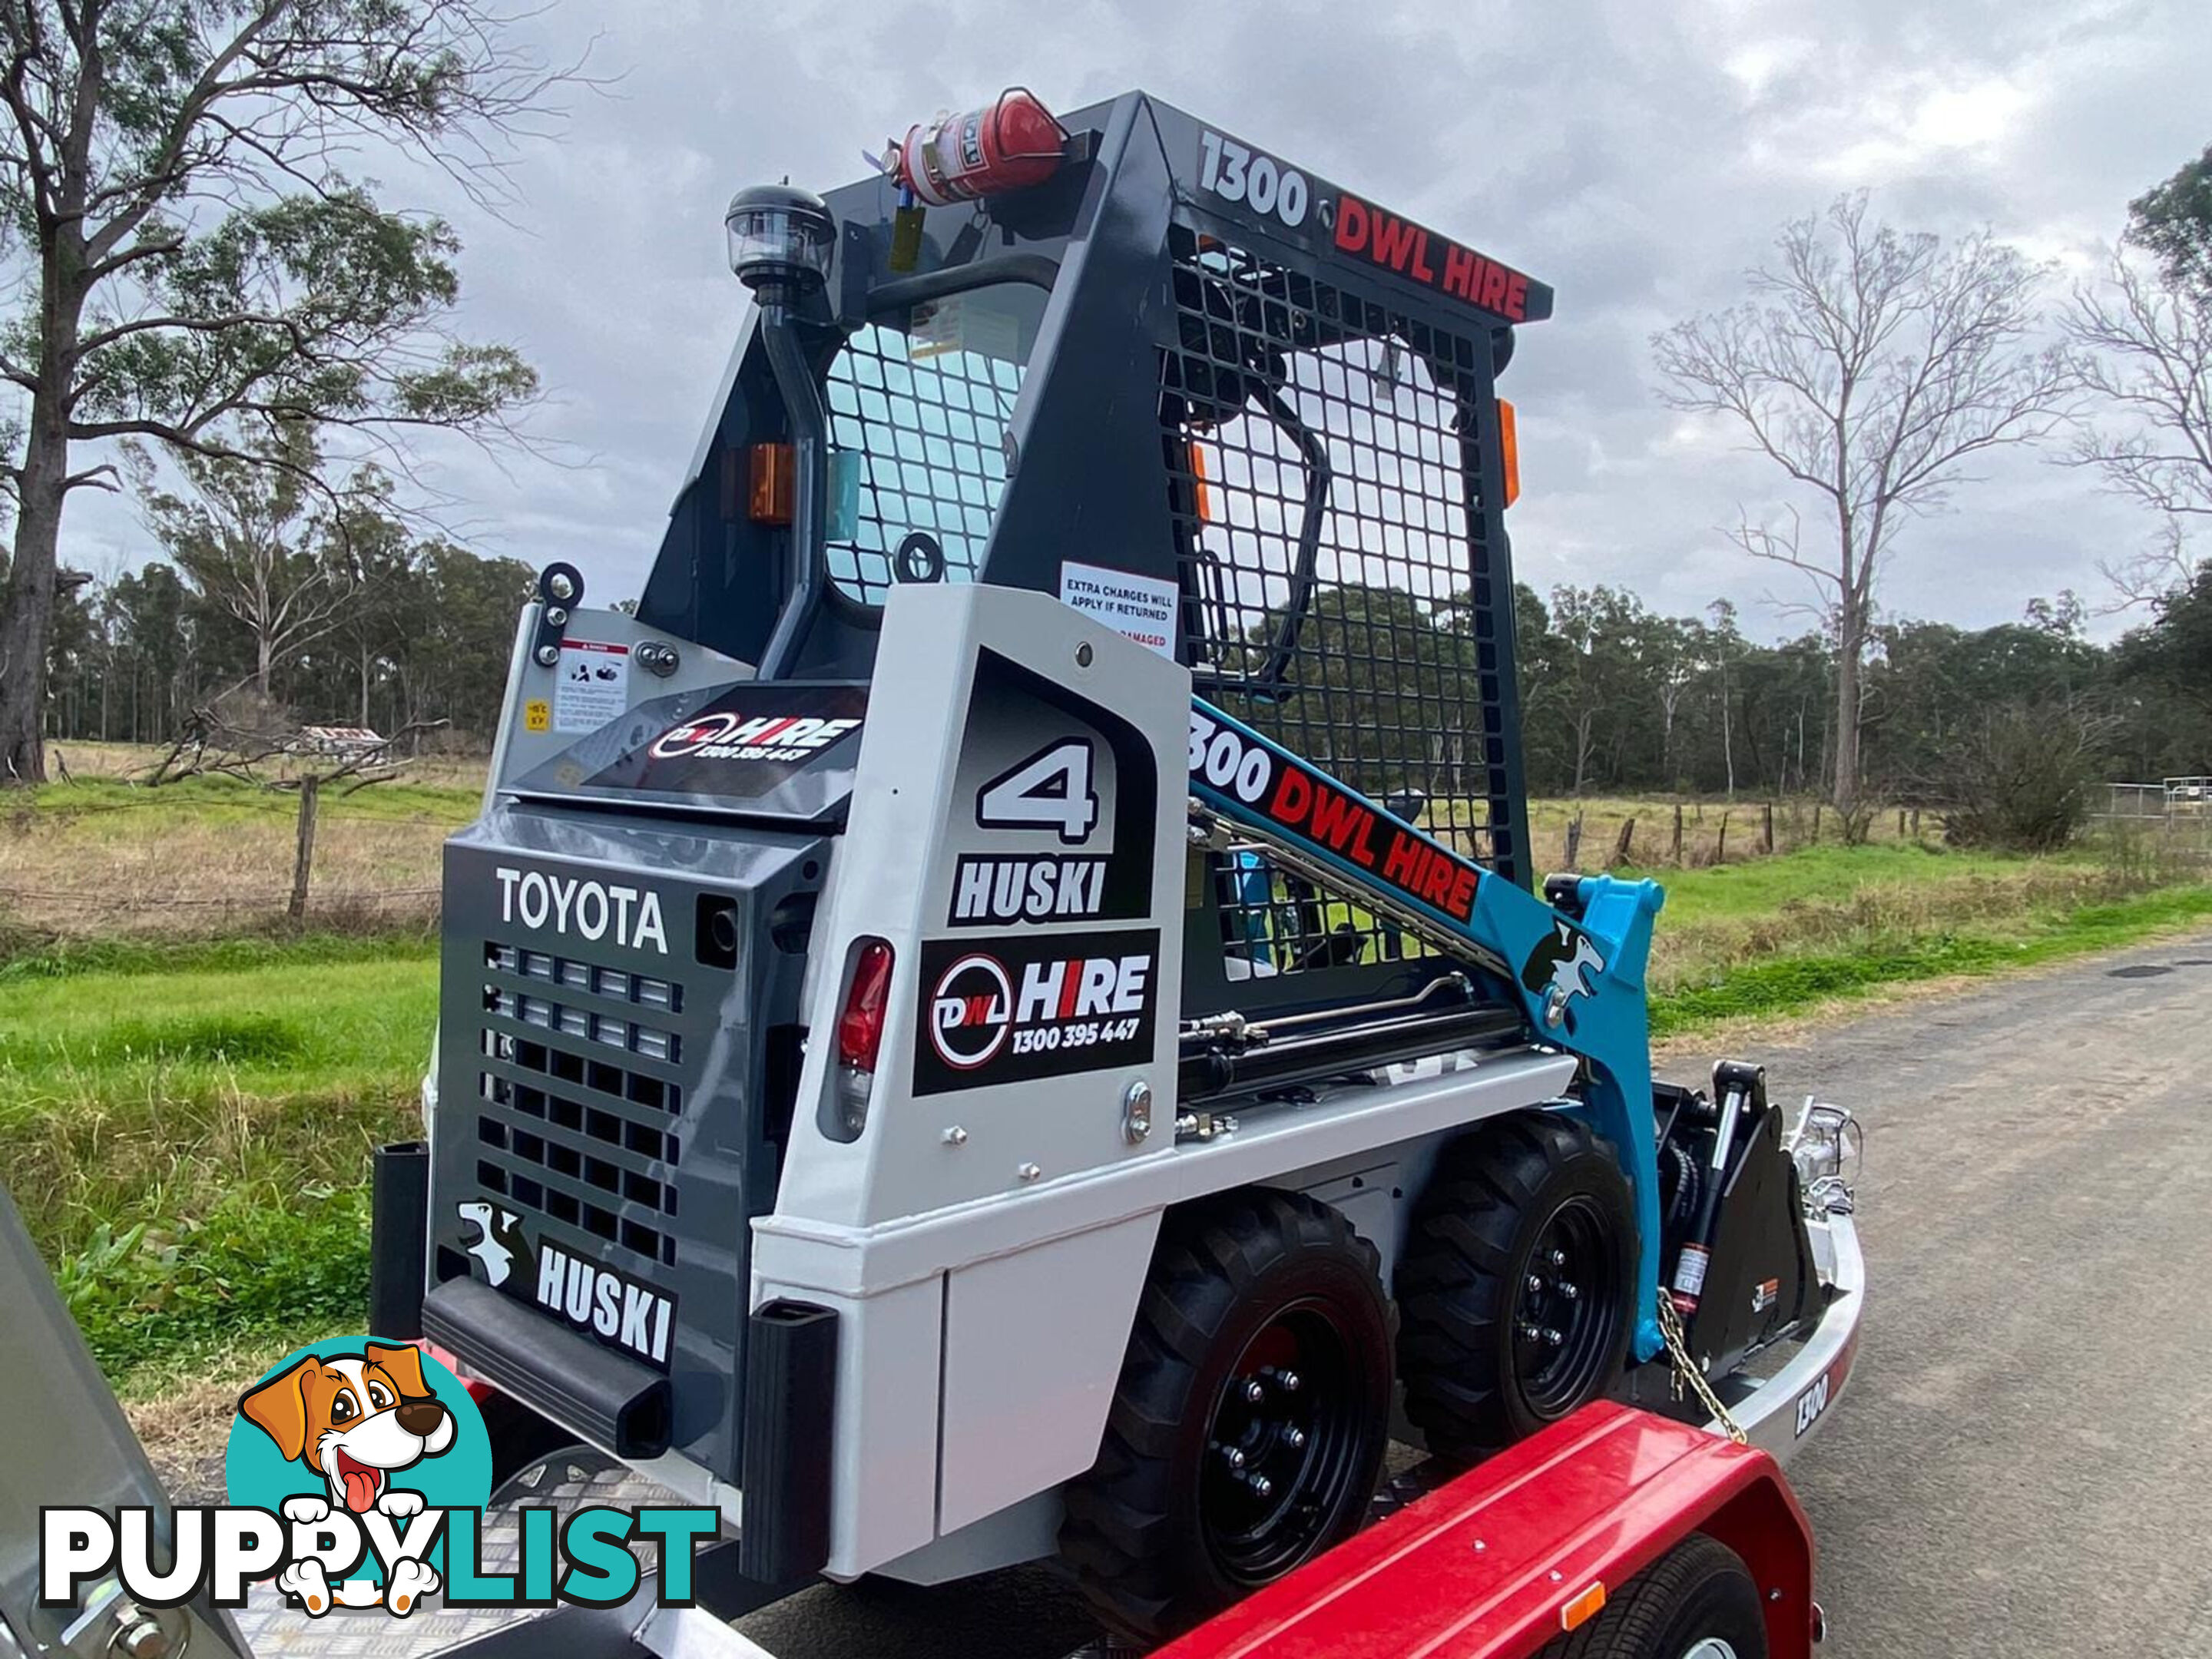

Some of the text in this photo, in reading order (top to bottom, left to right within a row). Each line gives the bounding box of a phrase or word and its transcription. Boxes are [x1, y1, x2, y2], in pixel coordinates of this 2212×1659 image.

[1200, 131, 1527, 320] 1300 DWL HIRE
[1067, 578, 1172, 608] EXTRA CHARGES WILL
[1071, 595, 1167, 621] APPLY IF RETURNED
[1121, 630, 1166, 647] MAGED
[720, 717, 863, 747] HIRE
[982, 743, 1094, 837] 4
[1271, 766, 1375, 867] DWL
[1383, 830, 1477, 919] HIRE
[496, 867, 668, 954] TOYOTA
[955, 860, 1107, 919] HUSKI
[933, 955, 1151, 1028] DWL HIRE
[1012, 1018, 1141, 1054] 1300 395 447
[538, 1245, 672, 1363] HUSKI
